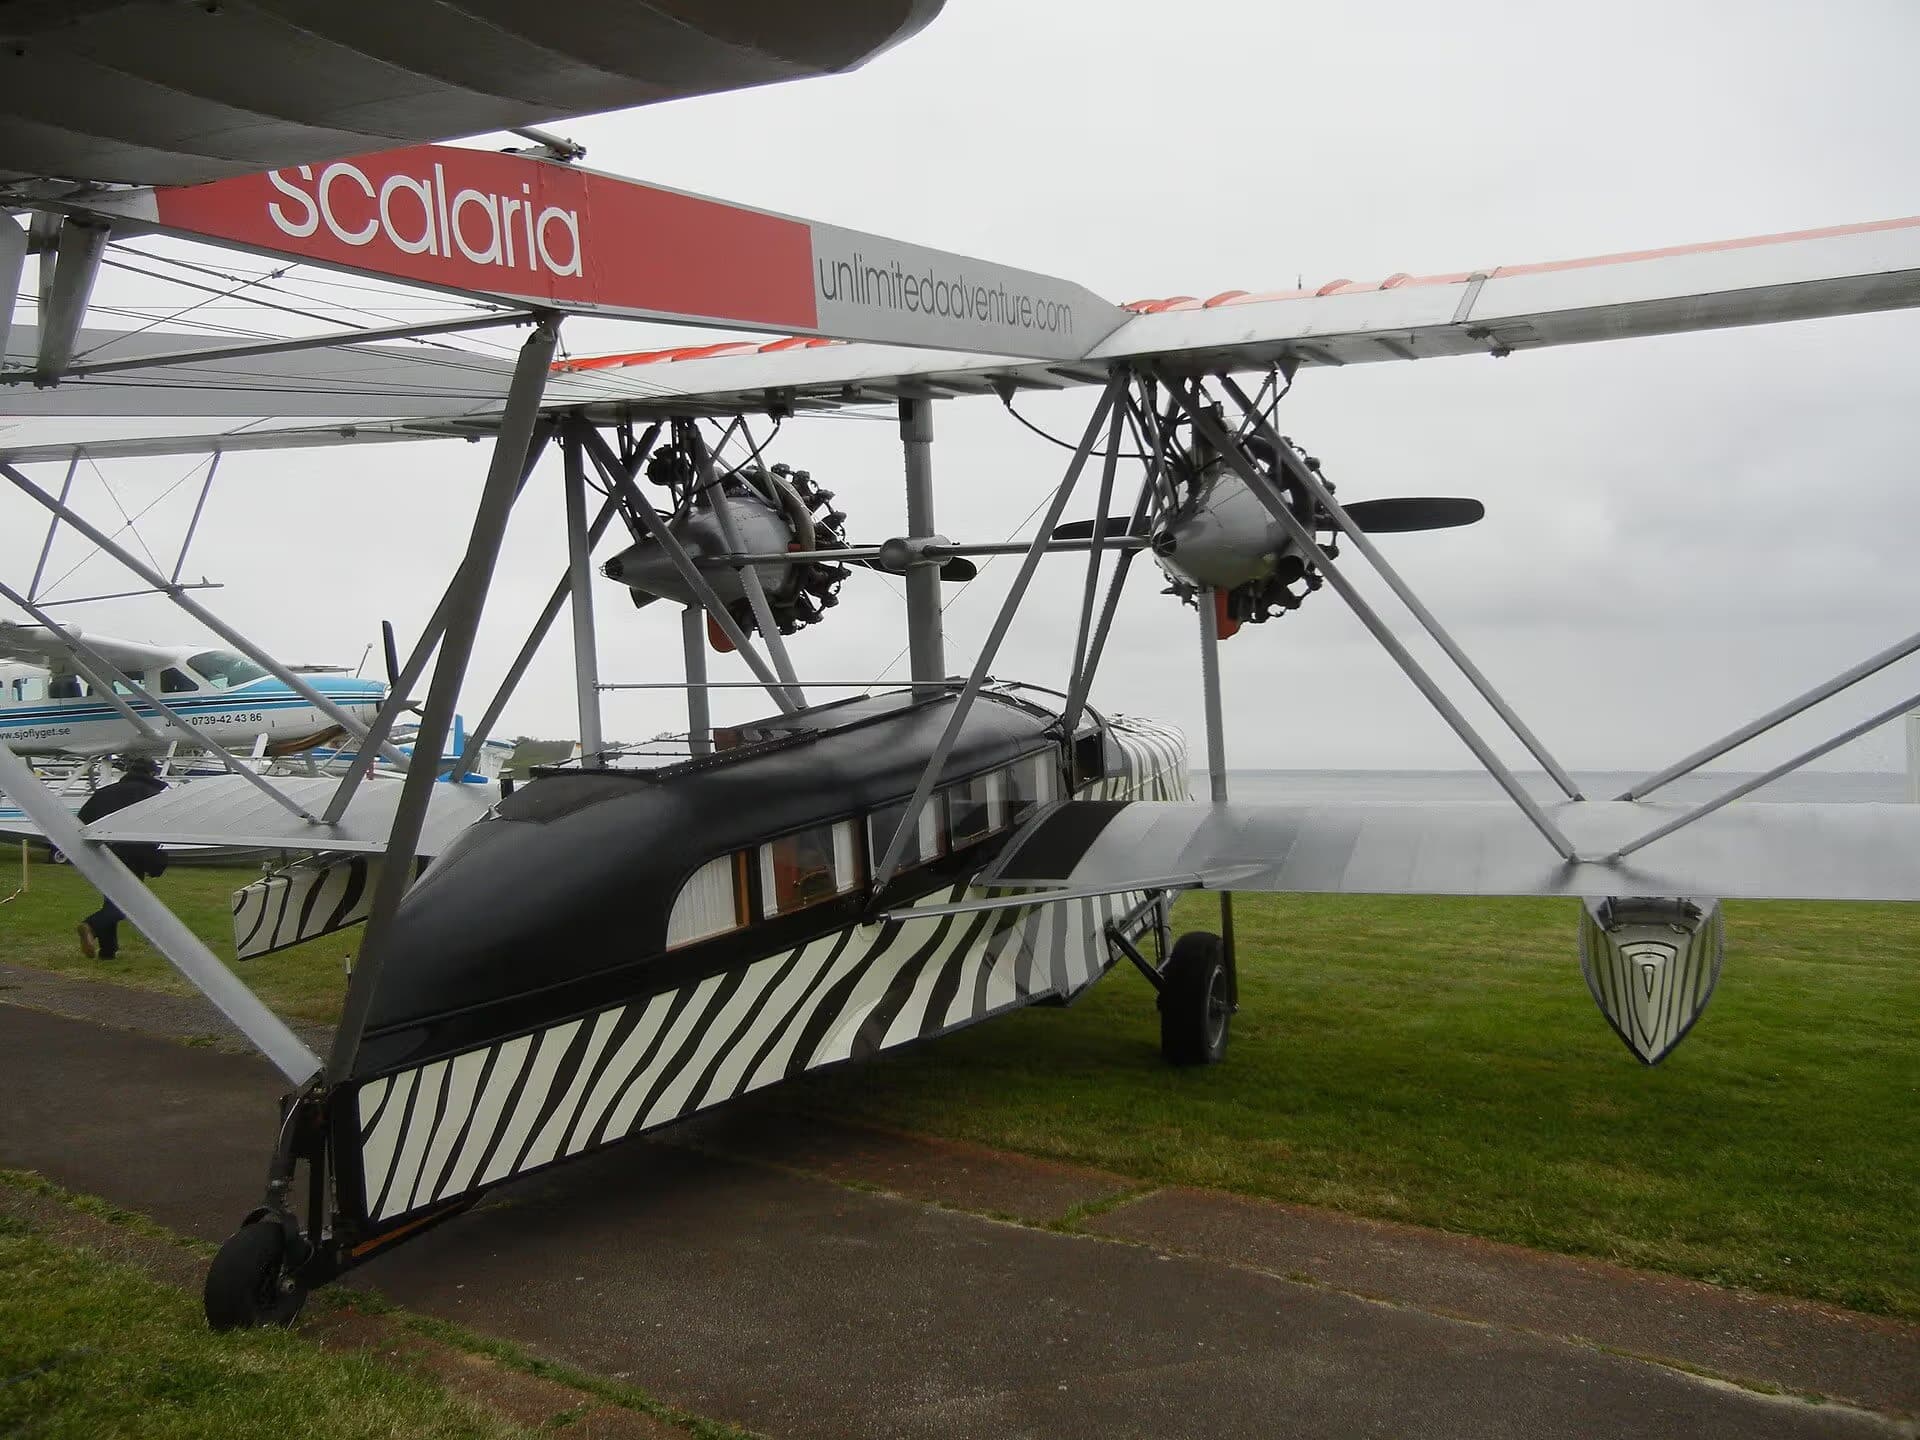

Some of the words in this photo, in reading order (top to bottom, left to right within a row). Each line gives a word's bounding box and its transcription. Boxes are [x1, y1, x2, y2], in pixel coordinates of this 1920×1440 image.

[819, 252, 1073, 335] unlimitedadventure.com
[192, 715, 232, 726] 0739-42
[234, 714, 247, 722] 43
[250, 713, 263, 721] 86
